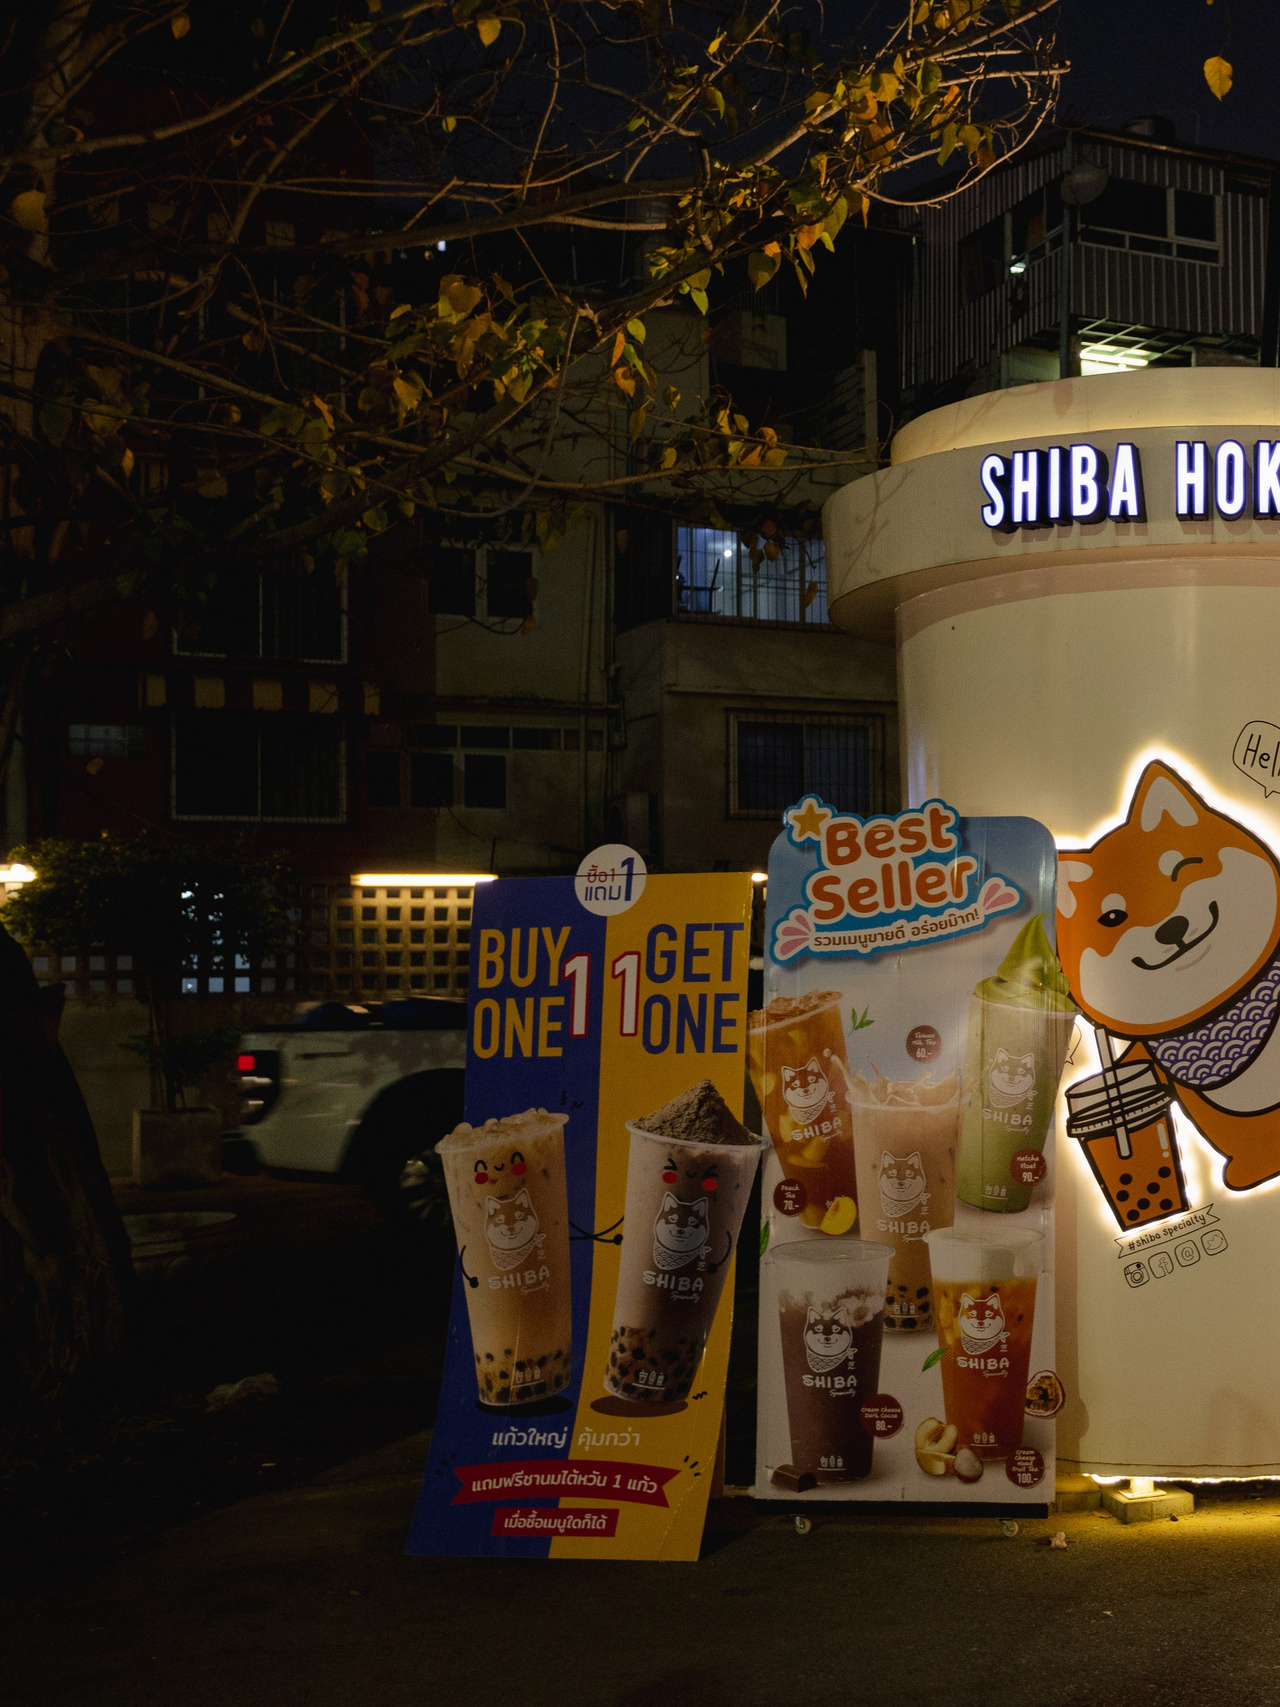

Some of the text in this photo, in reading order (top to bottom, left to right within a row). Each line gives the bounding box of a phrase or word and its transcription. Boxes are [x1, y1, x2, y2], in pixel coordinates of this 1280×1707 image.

[980, 443, 1140, 529] SHIBA
[825, 807, 953, 866] Best
[620, 856, 635, 902] 1
[811, 860, 974, 921] Seller
[584, 885, 621, 901] แถม
[814, 924, 905, 949] รวมเมนูขายดี
[478, 925, 572, 989] BUY
[645, 922, 745, 984] GET
[562, 952, 591, 1039] 1
[611, 950, 641, 1037] 1
[472, 995, 566, 1060] ONE
[641, 992, 741, 1055] ONE
[791, 1116, 843, 1141] SHIBA
[982, 1108, 1033, 1126] SHIBA
[1022, 1171, 1040, 1182] 90.-
[783, 1199, 800, 1211] 70.-
[876, 1218, 931, 1234] SHIBA
[1127, 1232, 1162, 1251] #shiba
[488, 1265, 550, 1290] SHIBA
[642, 1270, 704, 1292] SHIBA
[956, 1356, 1010, 1370] SHIBA
[802, 1374, 858, 1389] SHIBA
[491, 1425, 641, 1451] แก้วใหญ่ คุ้มกว่า
[875, 1420, 893, 1431] 80.-
[471, 1468, 658, 1494] แถมฟรีชานมไต้หวัน 1 แก้ว
[1017, 1473, 1039, 1484] 100.-
[504, 1509, 608, 1534] เมื่อซื้อเมนูใดก็ได้
